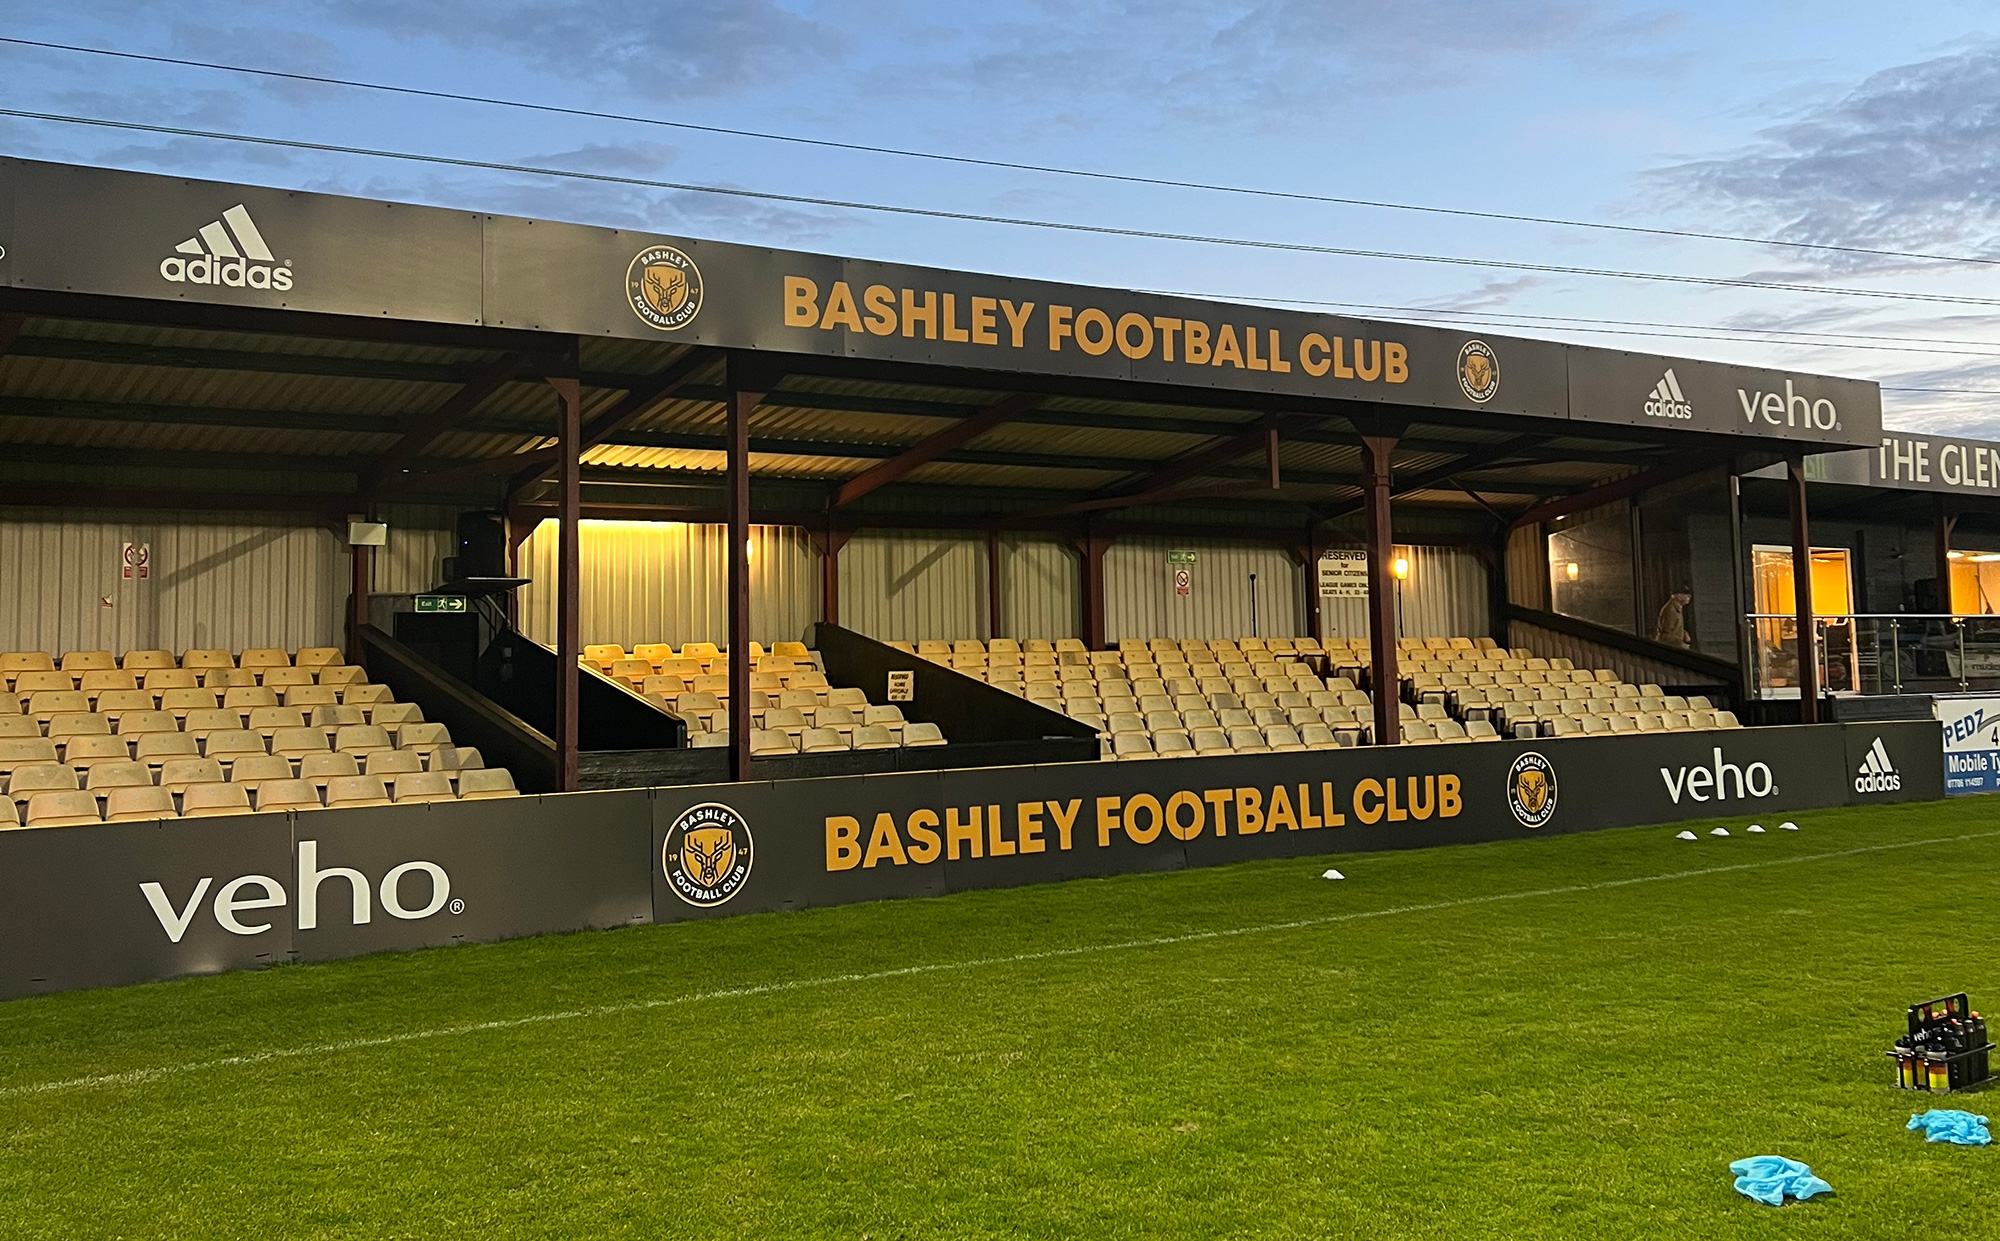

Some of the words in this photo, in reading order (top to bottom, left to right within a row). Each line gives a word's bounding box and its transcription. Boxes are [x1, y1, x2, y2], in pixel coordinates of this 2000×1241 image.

[160, 253, 294, 291] adidas
[641, 251, 689, 269] BASHLEY
[634, 295, 675, 325] FOOTBALL
[676, 301, 696, 322] CLUB
[784, 275, 1035, 348] BASHLEY
[1049, 304, 1291, 373] FOOTBALL
[1300, 332, 1409, 383] CLUB
[1644, 400, 1692, 419] adidas
[1737, 379, 1837, 431] veho
[1880, 438, 1931, 483] THE
[1322, 550, 1366, 560] RESERVED
[1942, 708, 1984, 748] PEDZ
[1515, 756, 1547, 772] BASHLEY
[1660, 747, 1773, 804] veho
[1948, 753, 1988, 773] Mobile
[1855, 772, 1901, 793] adidas
[679, 809, 736, 831] BASHLEY
[825, 798, 1083, 872] BASHLEY
[1096, 781, 1346, 847] FOOTBALL
[1353, 773, 1463, 825] CLUB
[1513, 800, 1541, 822] FOOTBALL
[1540, 798, 1553, 818] CLUB
[668, 853, 678, 862] 19
[738, 847, 748, 856] 47
[138, 840, 451, 944] veho
[672, 869, 723, 900] FOOTBALL
[722, 865, 745, 893] CLUB
